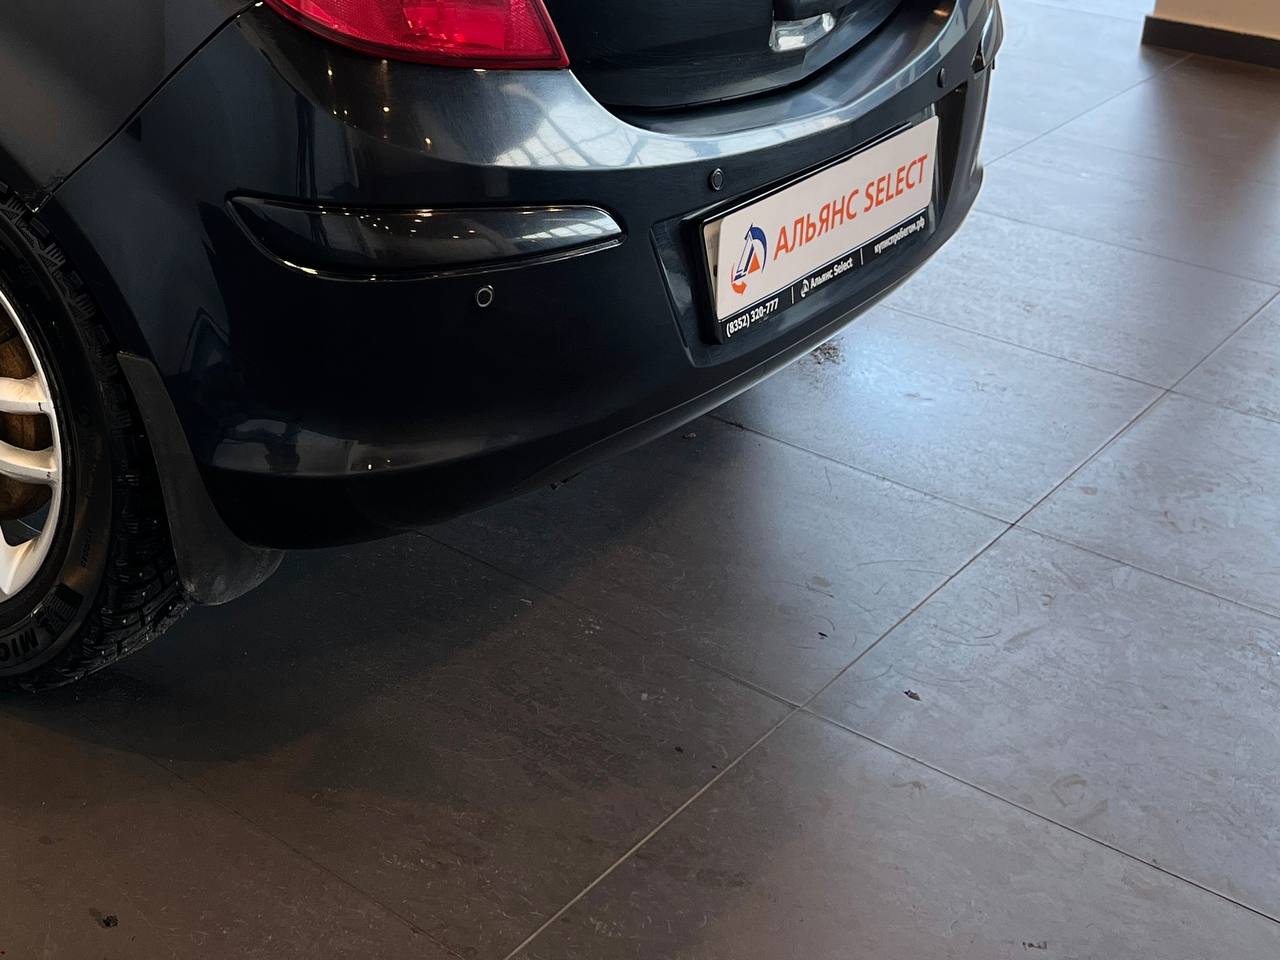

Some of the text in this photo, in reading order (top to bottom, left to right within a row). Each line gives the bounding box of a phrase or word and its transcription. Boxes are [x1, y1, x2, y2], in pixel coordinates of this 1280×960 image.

[773, 154, 928, 260] АЛЬЯНС SELECT
[810, 257, 853, 290] Альянс Select
[726, 297, 779, 338] (8352) 320-777
